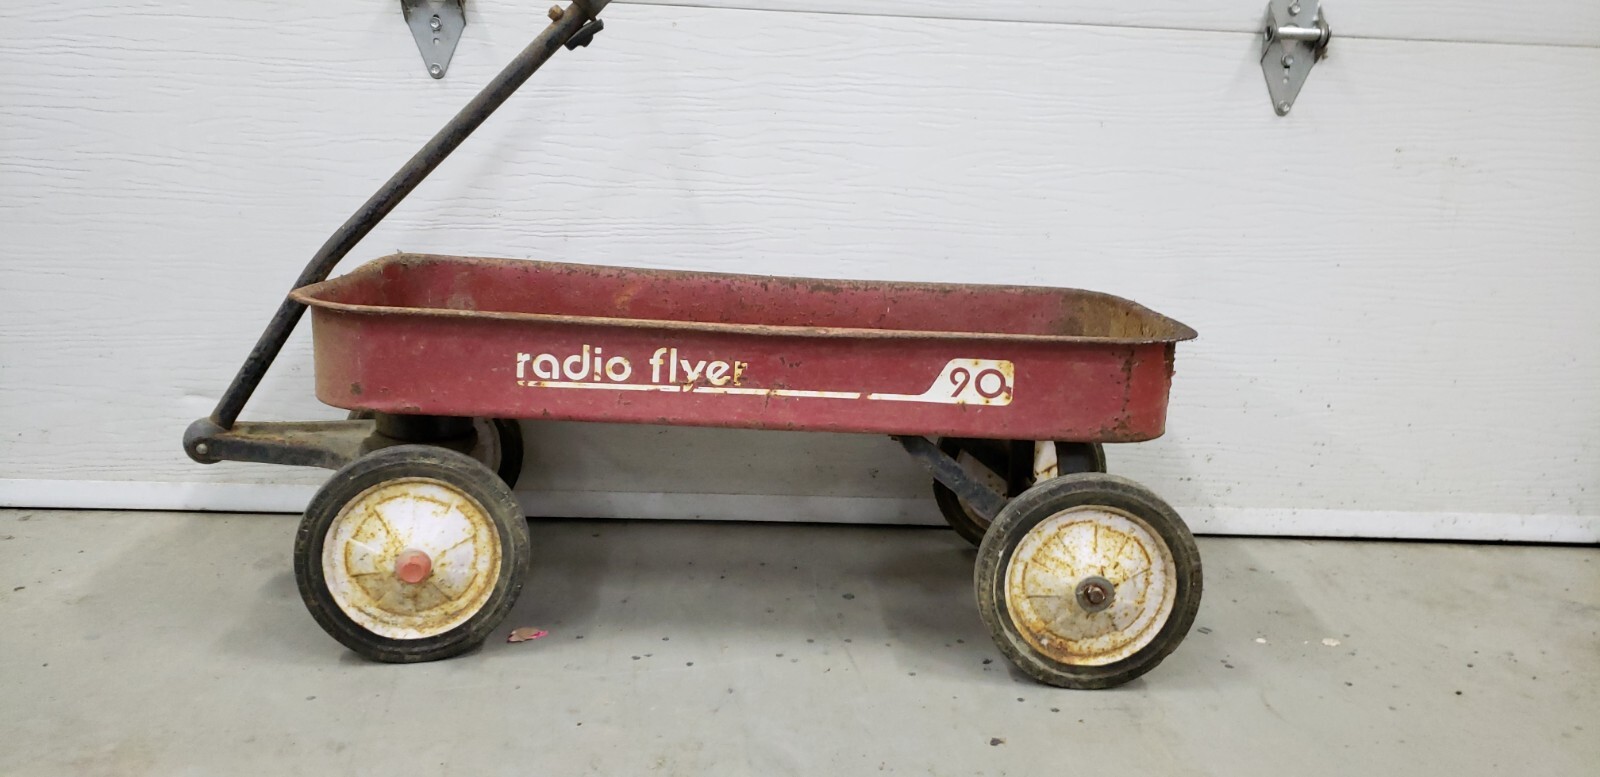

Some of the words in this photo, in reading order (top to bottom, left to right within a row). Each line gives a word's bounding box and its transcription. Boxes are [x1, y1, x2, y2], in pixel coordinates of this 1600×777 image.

[516, 344, 632, 382] radio
[649, 347, 748, 392] flyer
[949, 366, 1007, 399] 90
